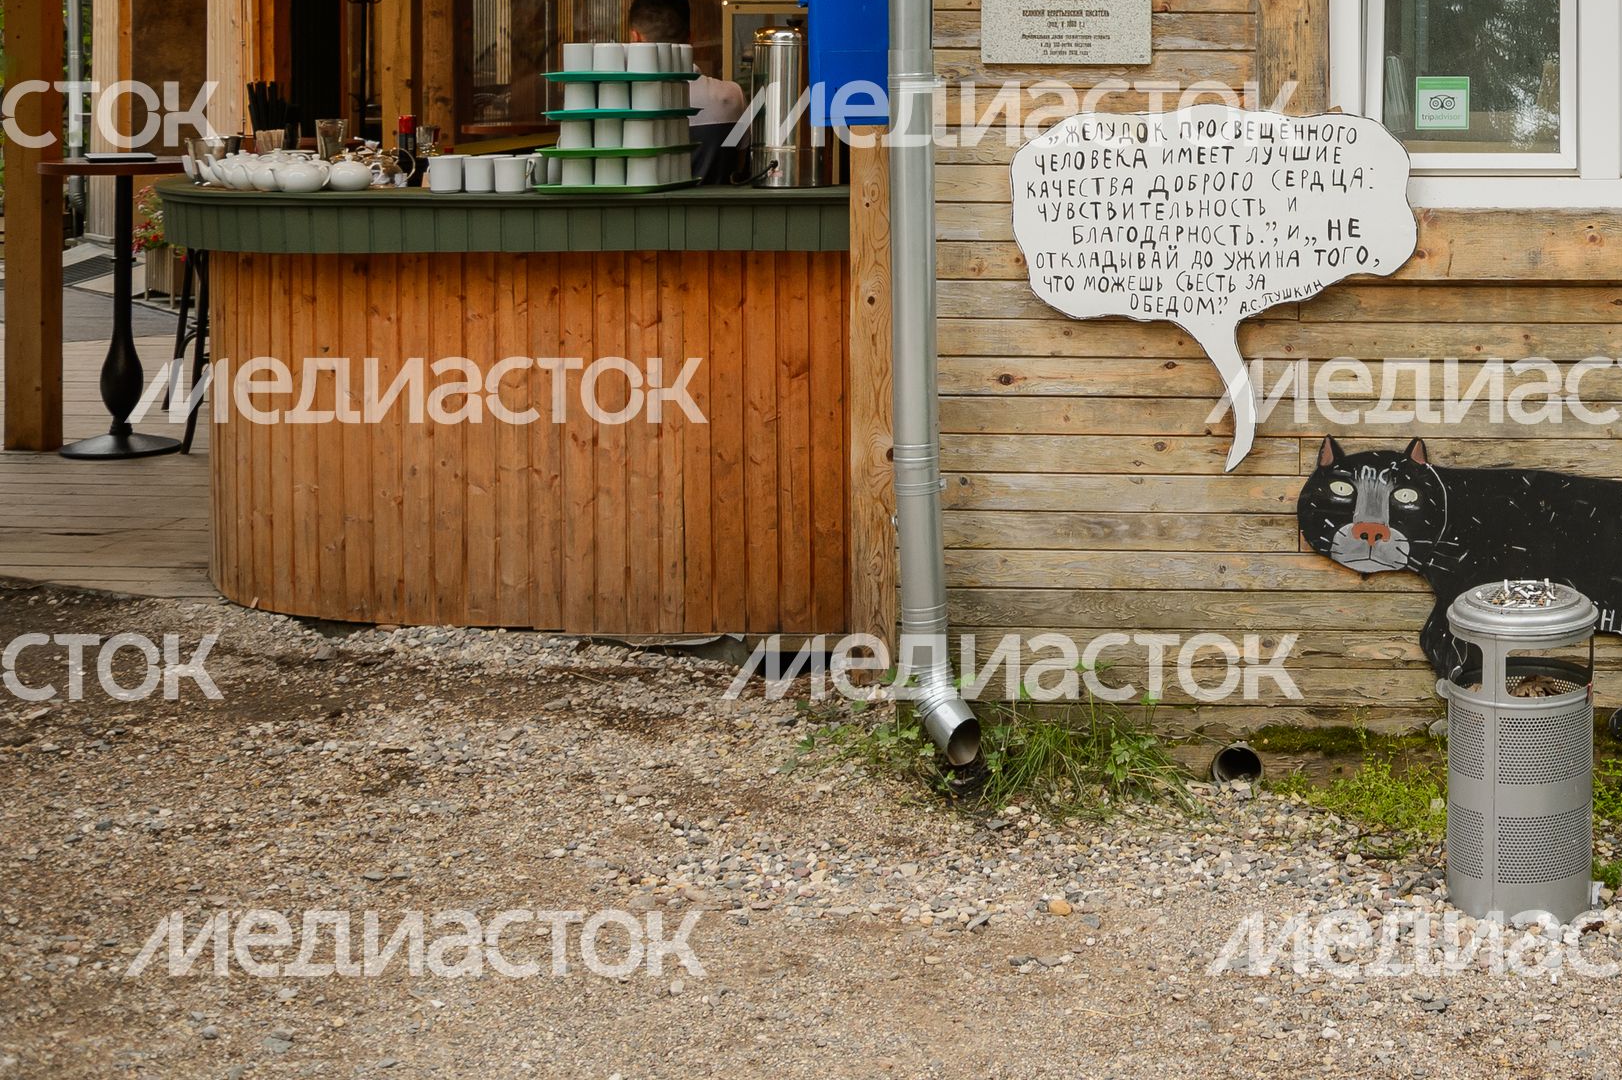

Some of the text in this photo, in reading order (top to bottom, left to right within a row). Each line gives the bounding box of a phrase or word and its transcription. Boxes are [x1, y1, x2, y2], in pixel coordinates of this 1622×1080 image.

[1034, 145, 1343, 174] ЧЕЛОВЕКА ИМЕЕТ ЛУЧШИЕ
[1026, 167, 1375, 201] КАЧЕСТВА ДОБРОГО СЕРДЦА:
[1037, 195, 1298, 222] ЧУВСТВИТЕЛЬНОСТЬ И
[1036, 244, 1380, 273] ОТКЛАДЫВАЙ ДО УЖИНА ТОГО,
[1043, 271, 1266, 293] ЧТО МОЖЕШЬ СЪЕСТЬ ЗА
[1262, 281, 1323, 306] ПУШКИН
